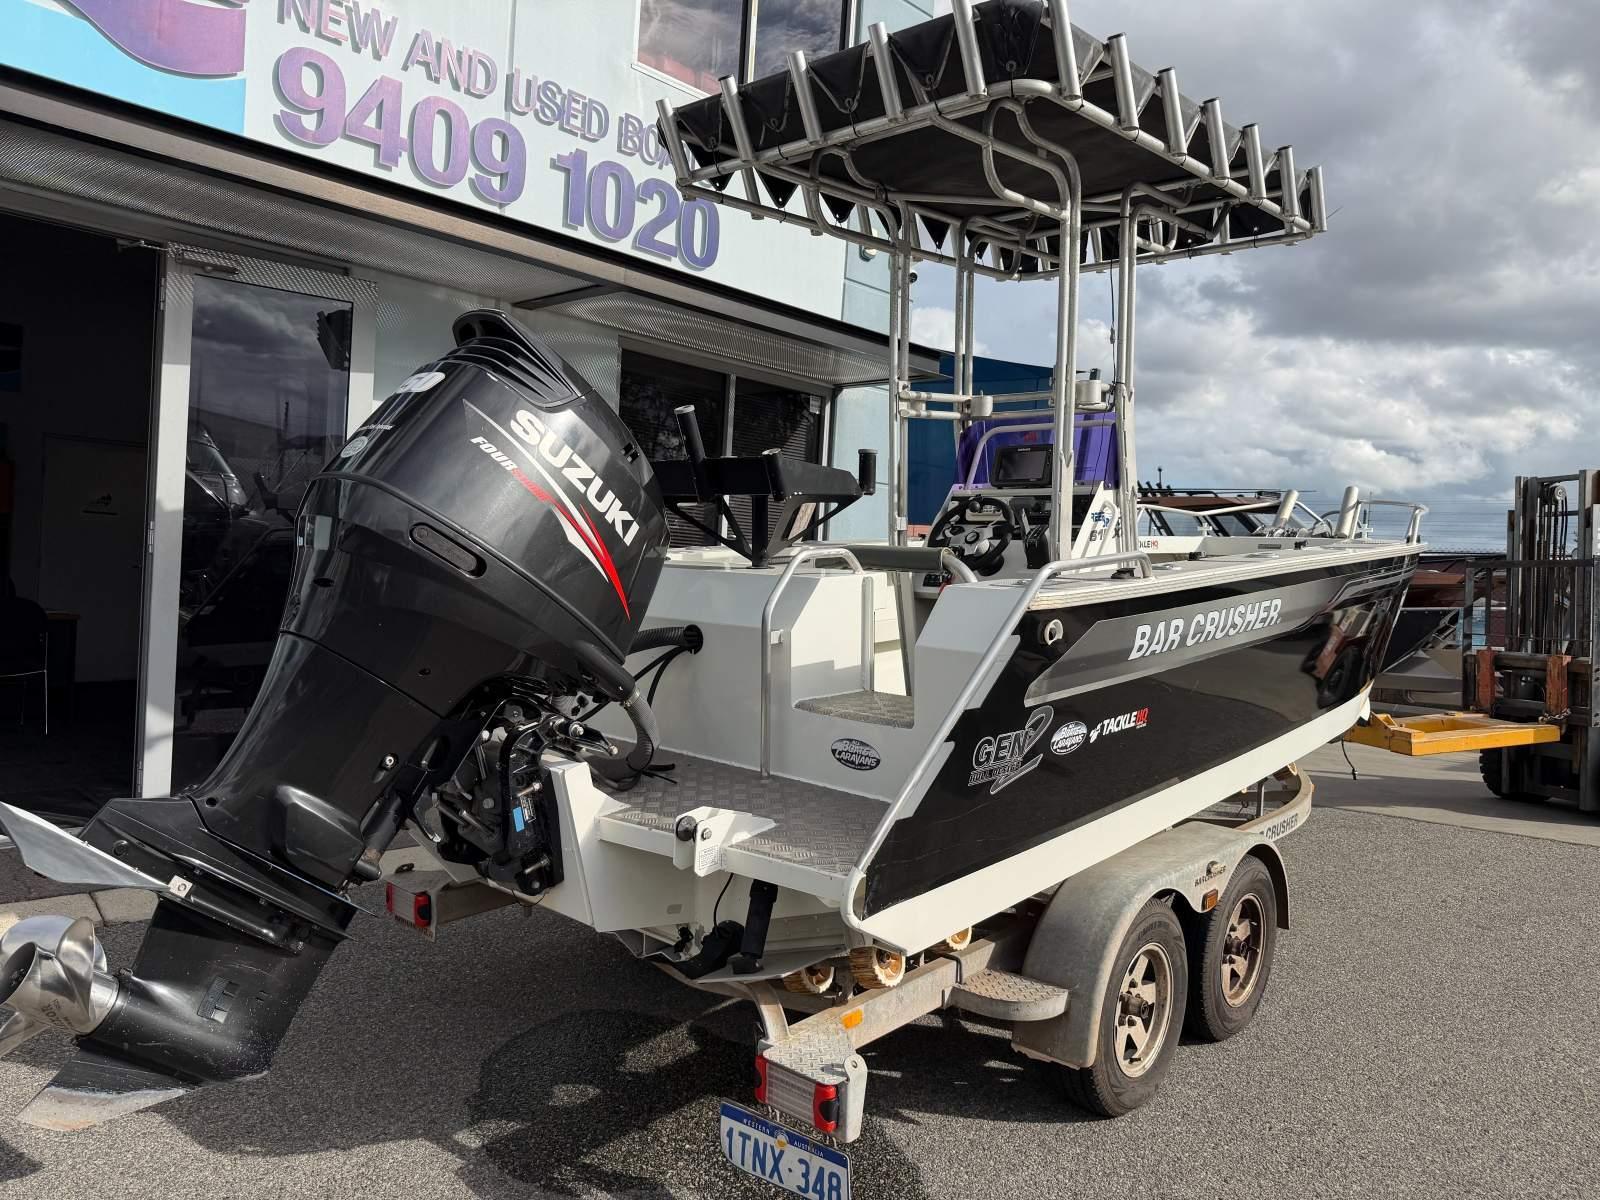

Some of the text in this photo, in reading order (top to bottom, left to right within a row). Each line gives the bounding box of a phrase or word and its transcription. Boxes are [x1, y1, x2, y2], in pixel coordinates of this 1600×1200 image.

[280, 0, 609, 140] NEW AND USED
[277, 47, 526, 204] 9409
[556, 148, 720, 268] 1020
[510, 409, 640, 547] SUZUKI
[1128, 599, 1282, 660] BAR CRUSHER
[835, 750, 877, 766] CARAVANS
[1265, 812, 1298, 840] CRUSHER
